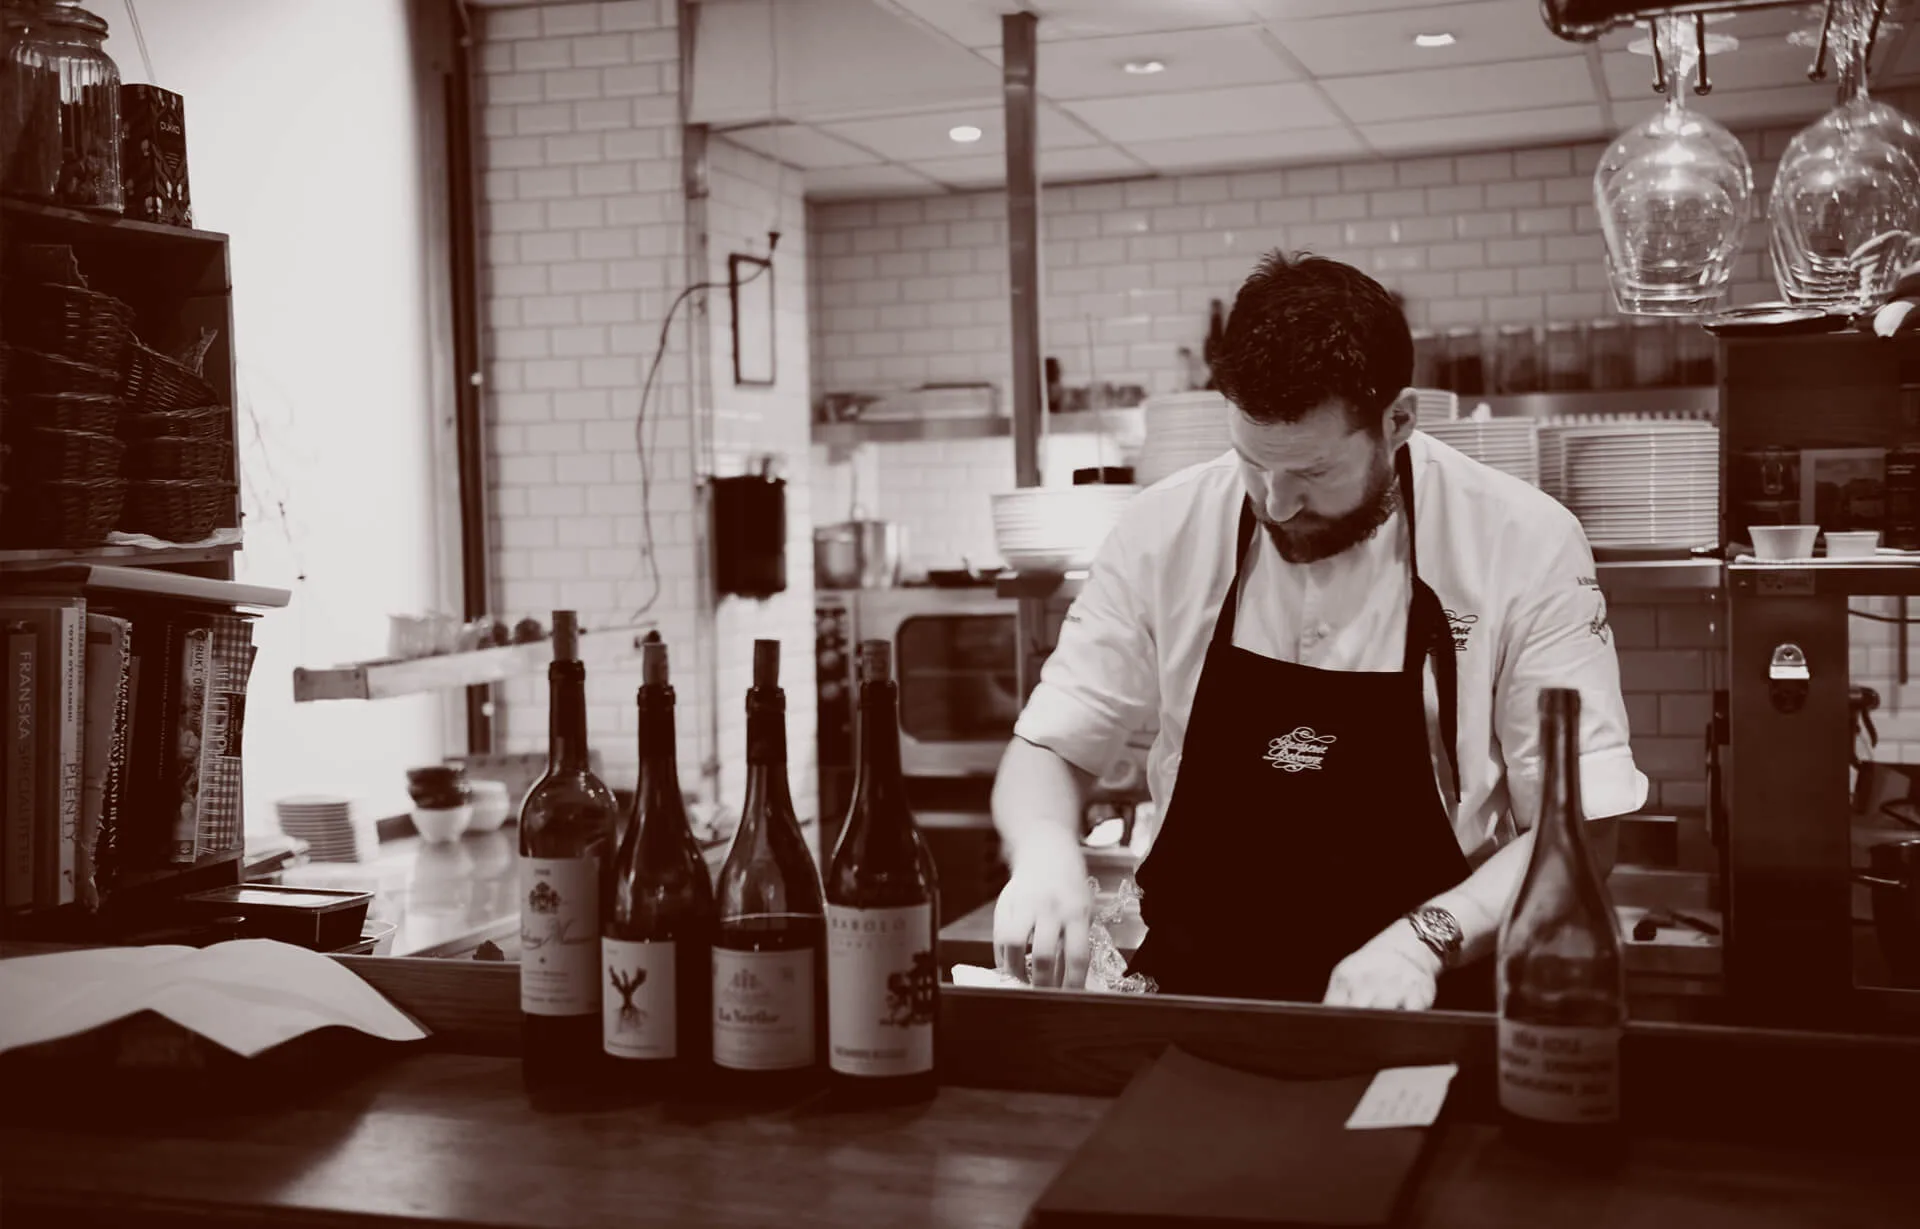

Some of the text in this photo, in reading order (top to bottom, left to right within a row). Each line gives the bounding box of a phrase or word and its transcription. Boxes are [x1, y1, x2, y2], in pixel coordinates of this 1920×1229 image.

[16, 651, 31, 875] FRANSKA SPECIALITETER
[65, 763, 83, 842] PLENTY
[831, 916, 906, 933] BAROLO
